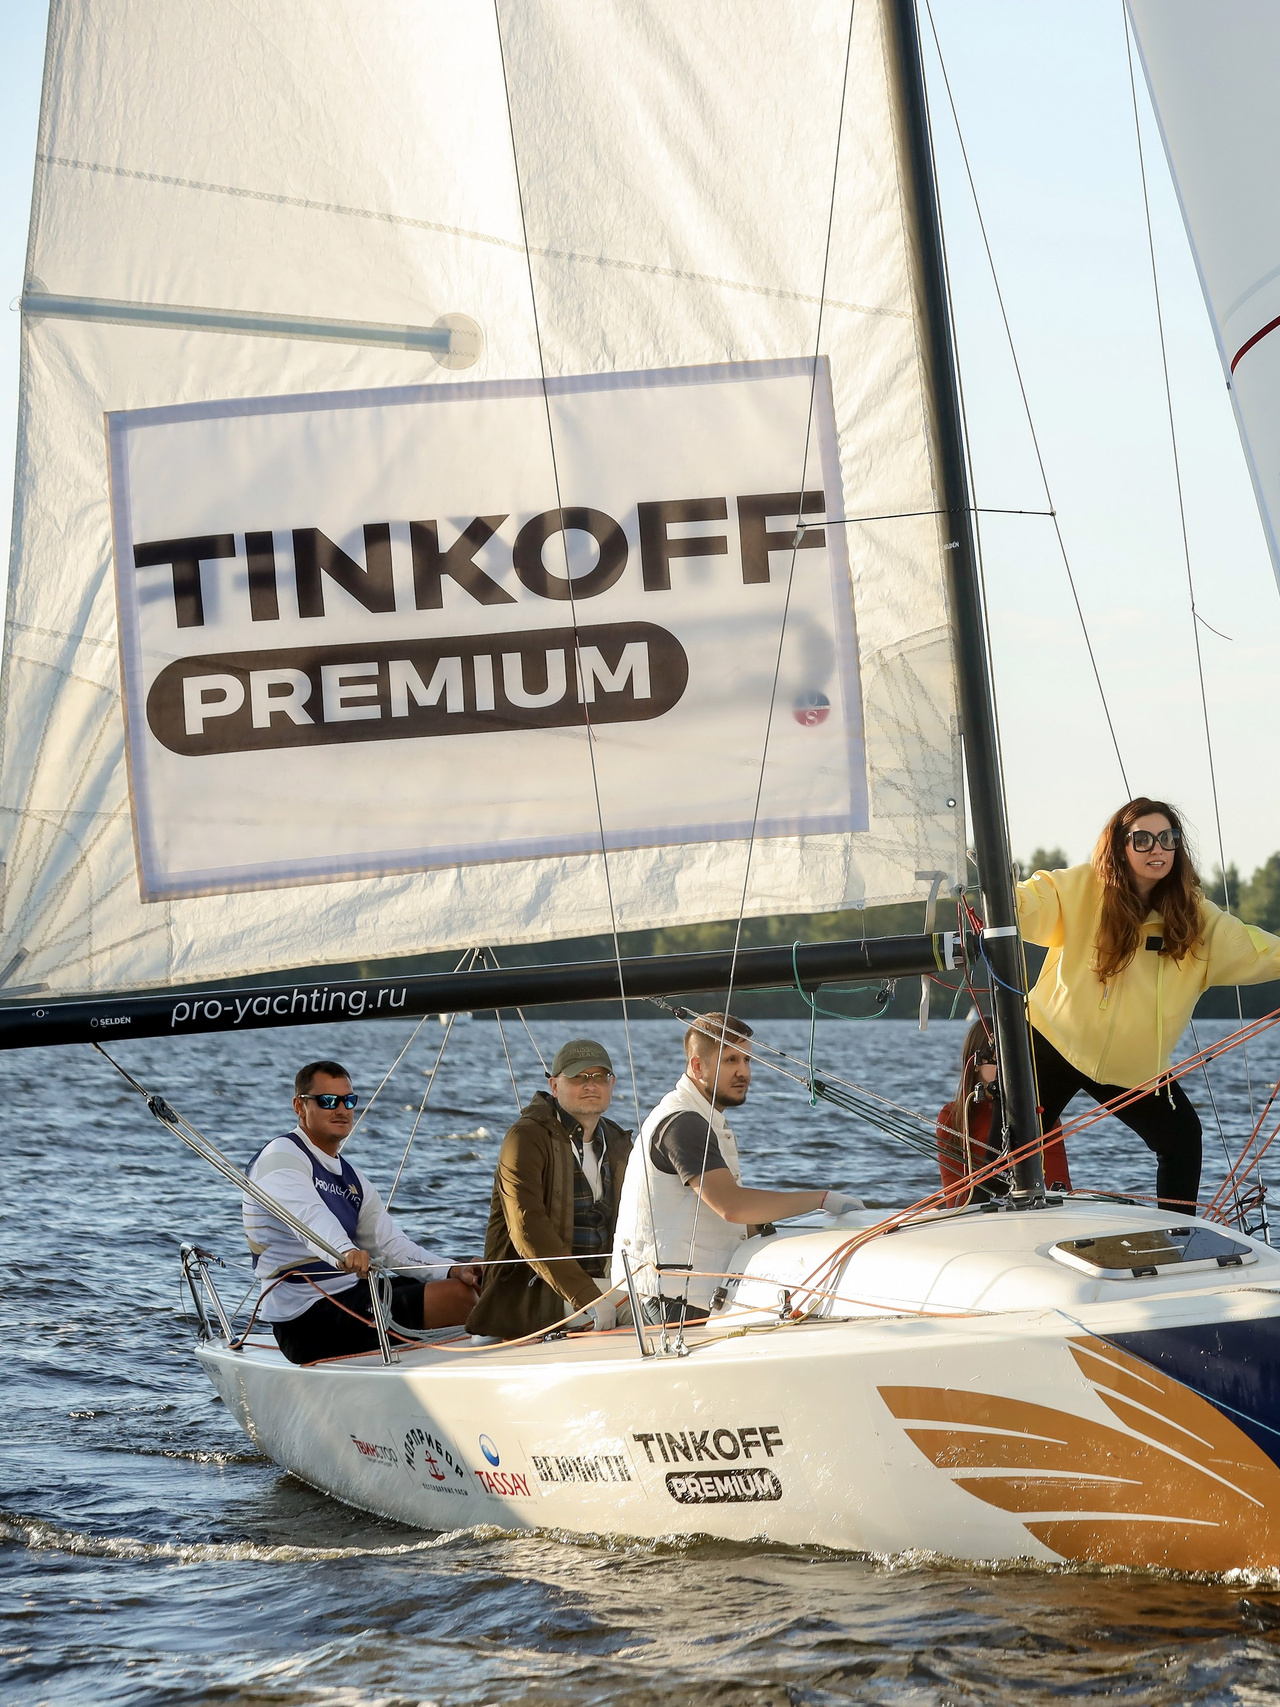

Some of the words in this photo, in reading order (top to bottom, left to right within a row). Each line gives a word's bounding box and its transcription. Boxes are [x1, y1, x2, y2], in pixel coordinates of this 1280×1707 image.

[133, 489, 827, 629] TINKOFF
[181, 641, 653, 736] PREMIUM
[170, 986, 408, 1028] pro-yachting.ru
[632, 1425, 784, 1463] TINKOFF
[474, 1470, 532, 1497] TASSAY
[670, 1472, 776, 1499] PREMIUM
